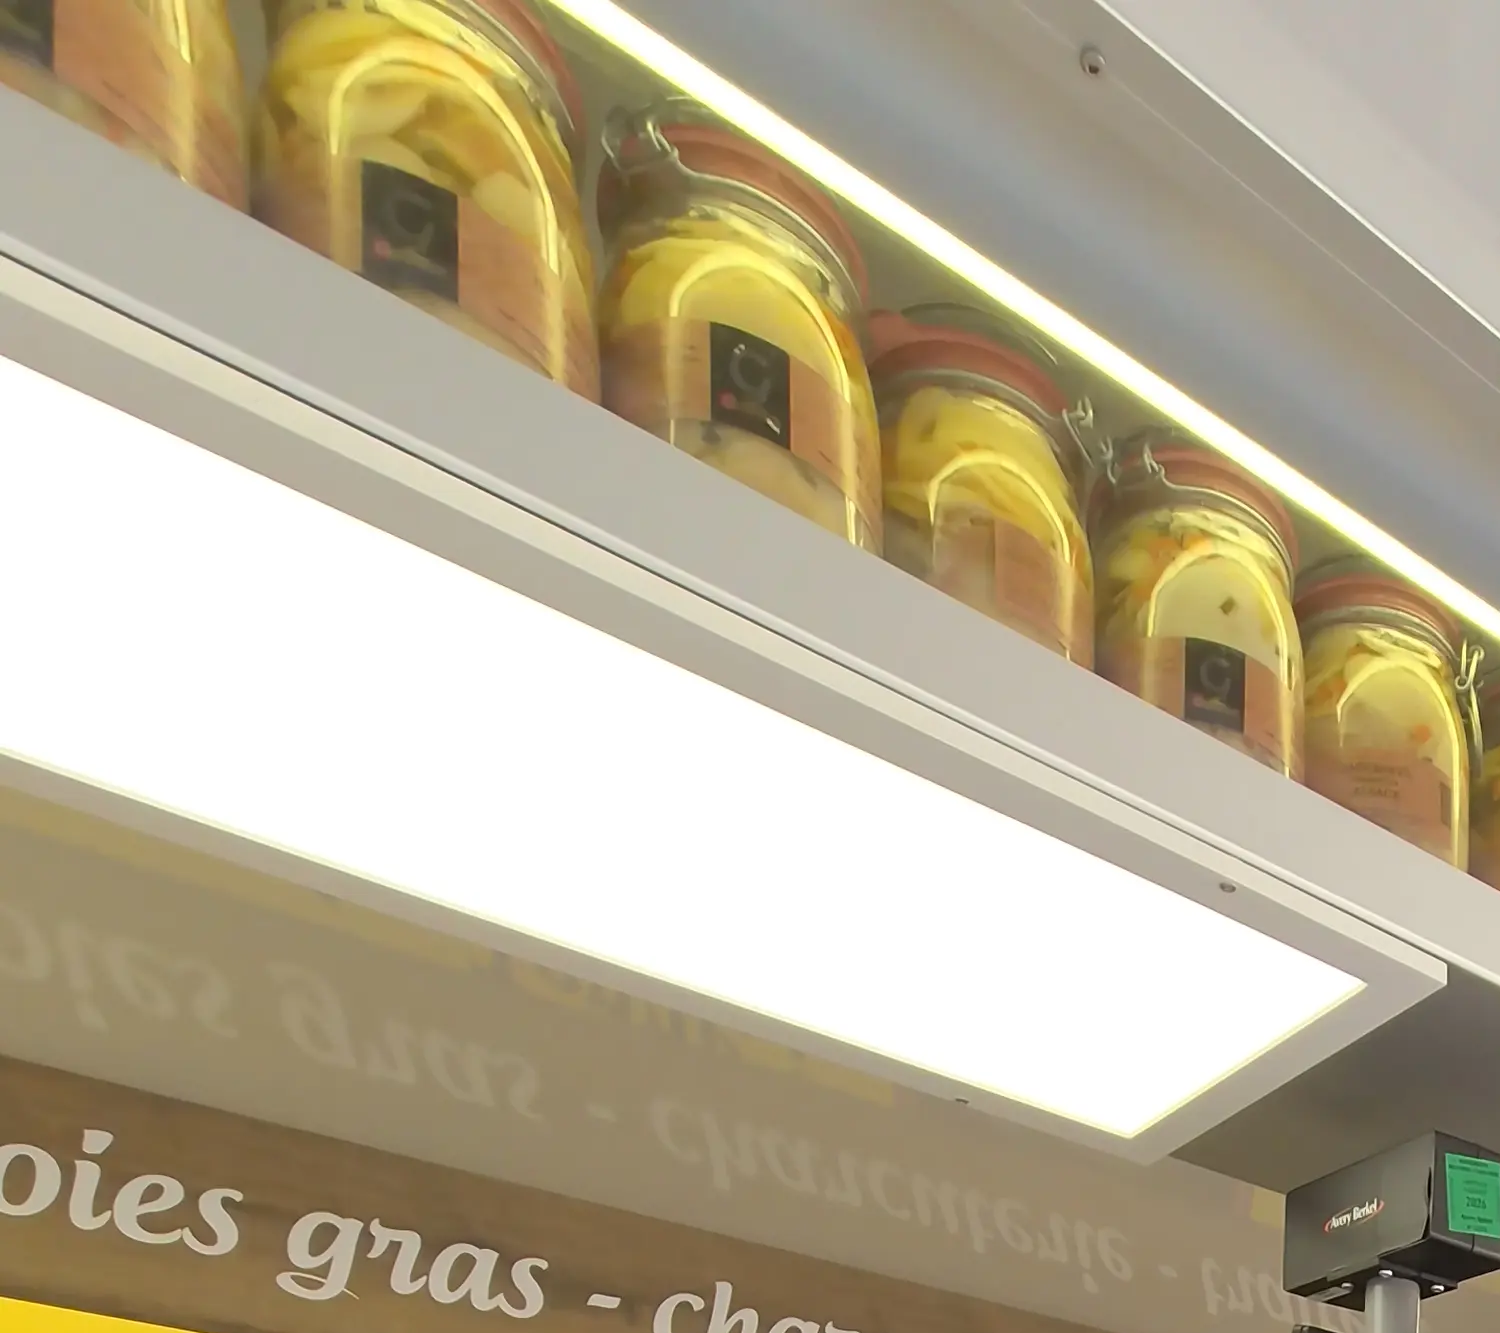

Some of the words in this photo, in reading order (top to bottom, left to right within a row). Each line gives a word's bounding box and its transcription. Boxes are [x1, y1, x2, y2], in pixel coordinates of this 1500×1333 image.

[0, 1128, 245, 1256] oies
[275, 1210, 550, 1320] gras
[1330, 1210, 1352, 1230] Avery
[1352, 1197, 1379, 1221] Berkel
